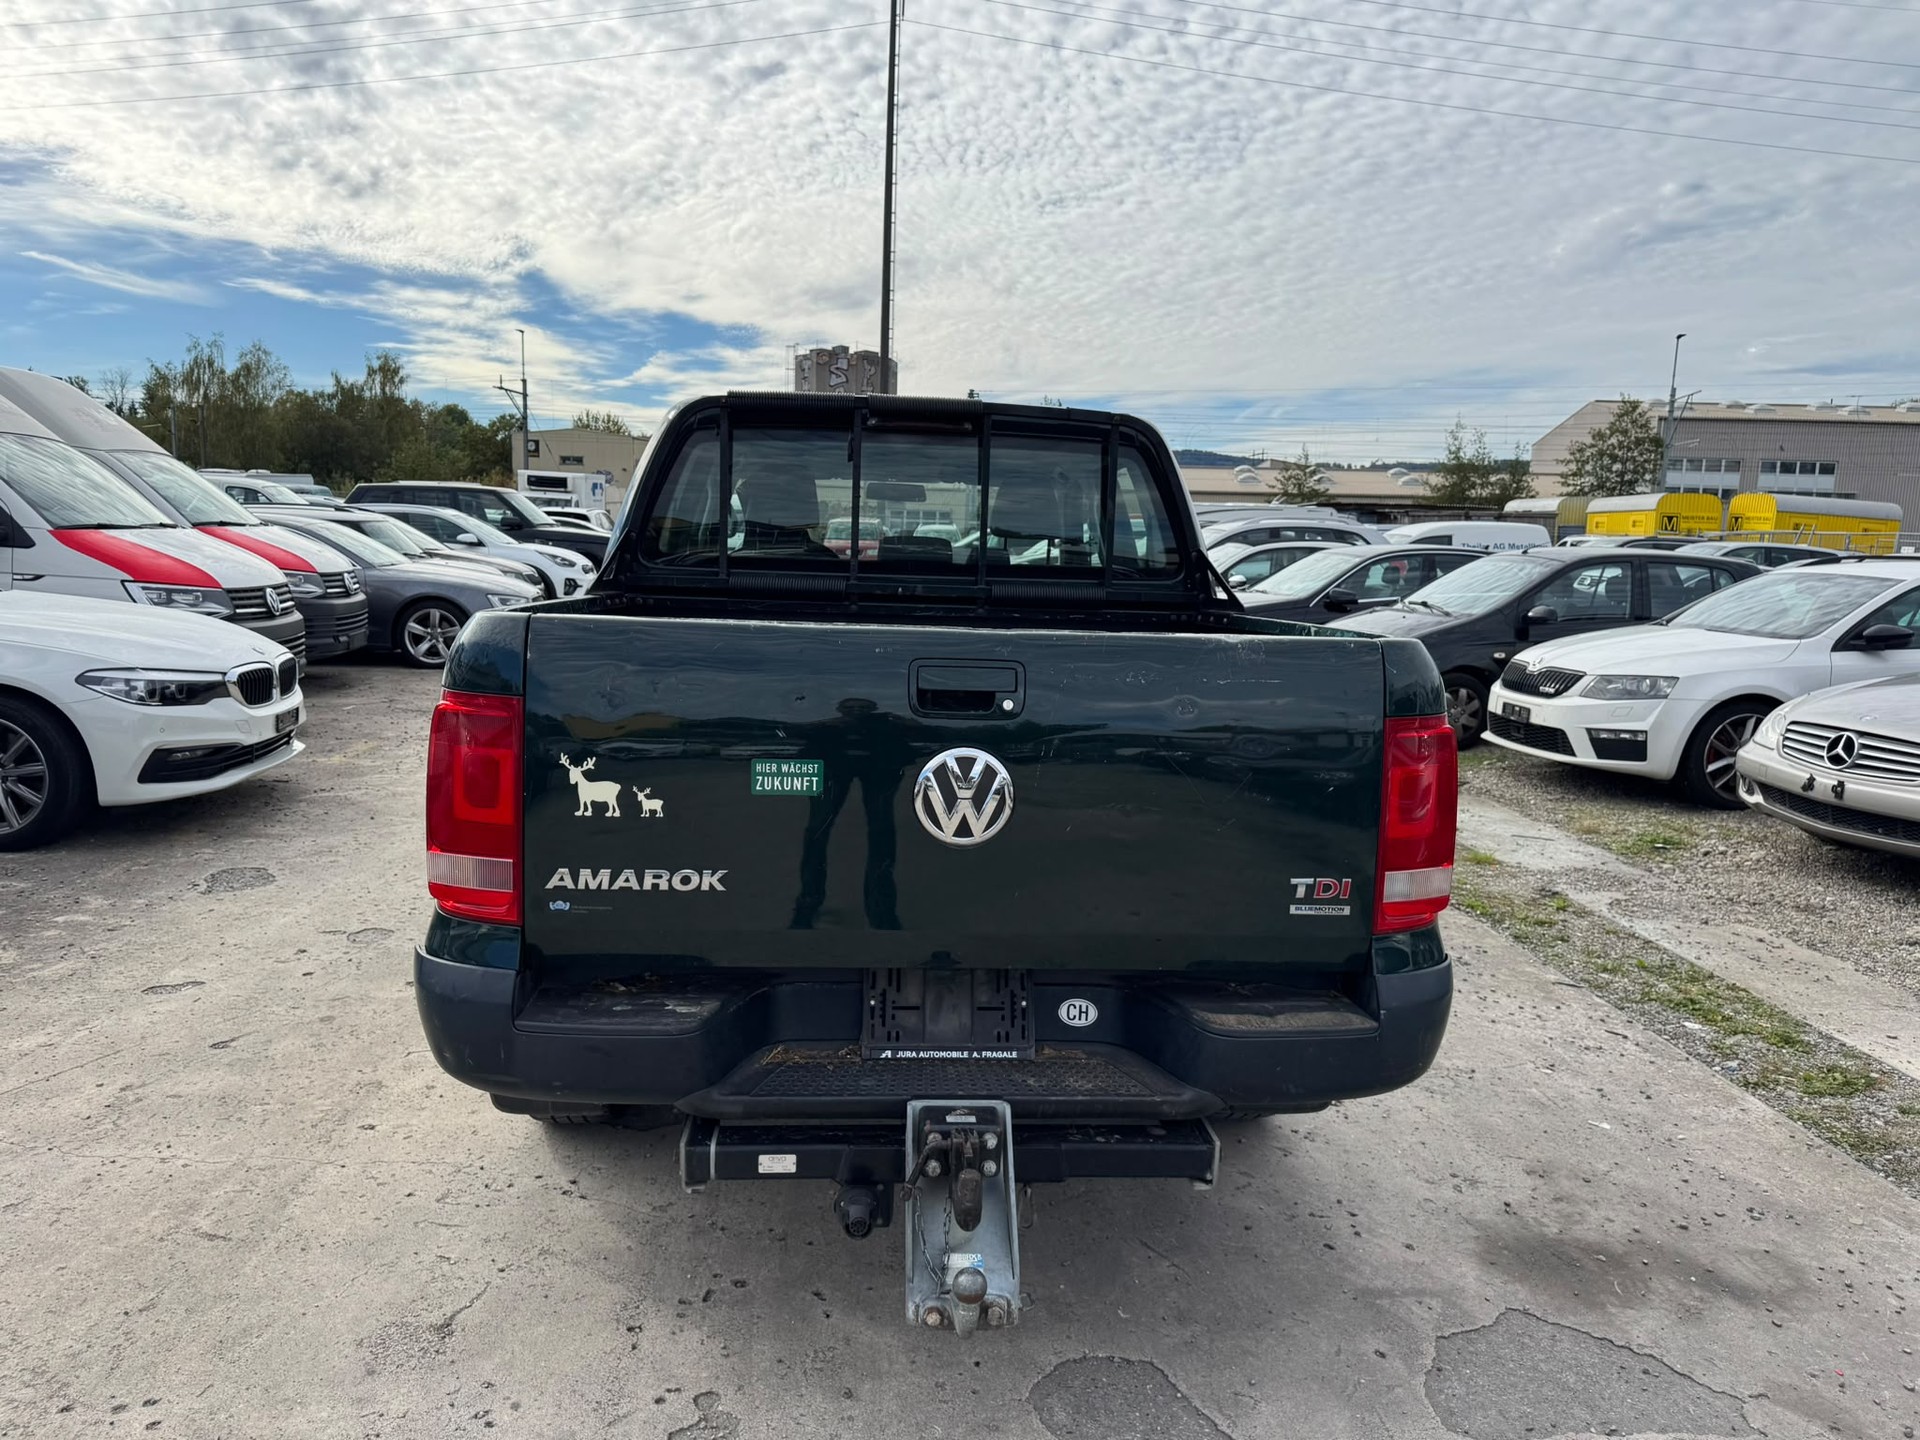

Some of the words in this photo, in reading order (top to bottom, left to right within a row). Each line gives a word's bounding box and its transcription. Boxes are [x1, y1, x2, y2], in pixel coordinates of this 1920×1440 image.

[756, 763, 777, 773] HIER
[781, 762, 818, 774] WÄCHST
[756, 776, 818, 791] ZUKUNFT
[544, 868, 729, 892] AMAROK
[1290, 878, 1352, 899] TDI
[1066, 1003, 1089, 1022] CH
[896, 1050, 917, 1058] JURA
[918, 1050, 969, 1058] AUTOMOBILE
[972, 1050, 981, 1059] A.
[982, 1051, 1018, 1059] FRAGALE
